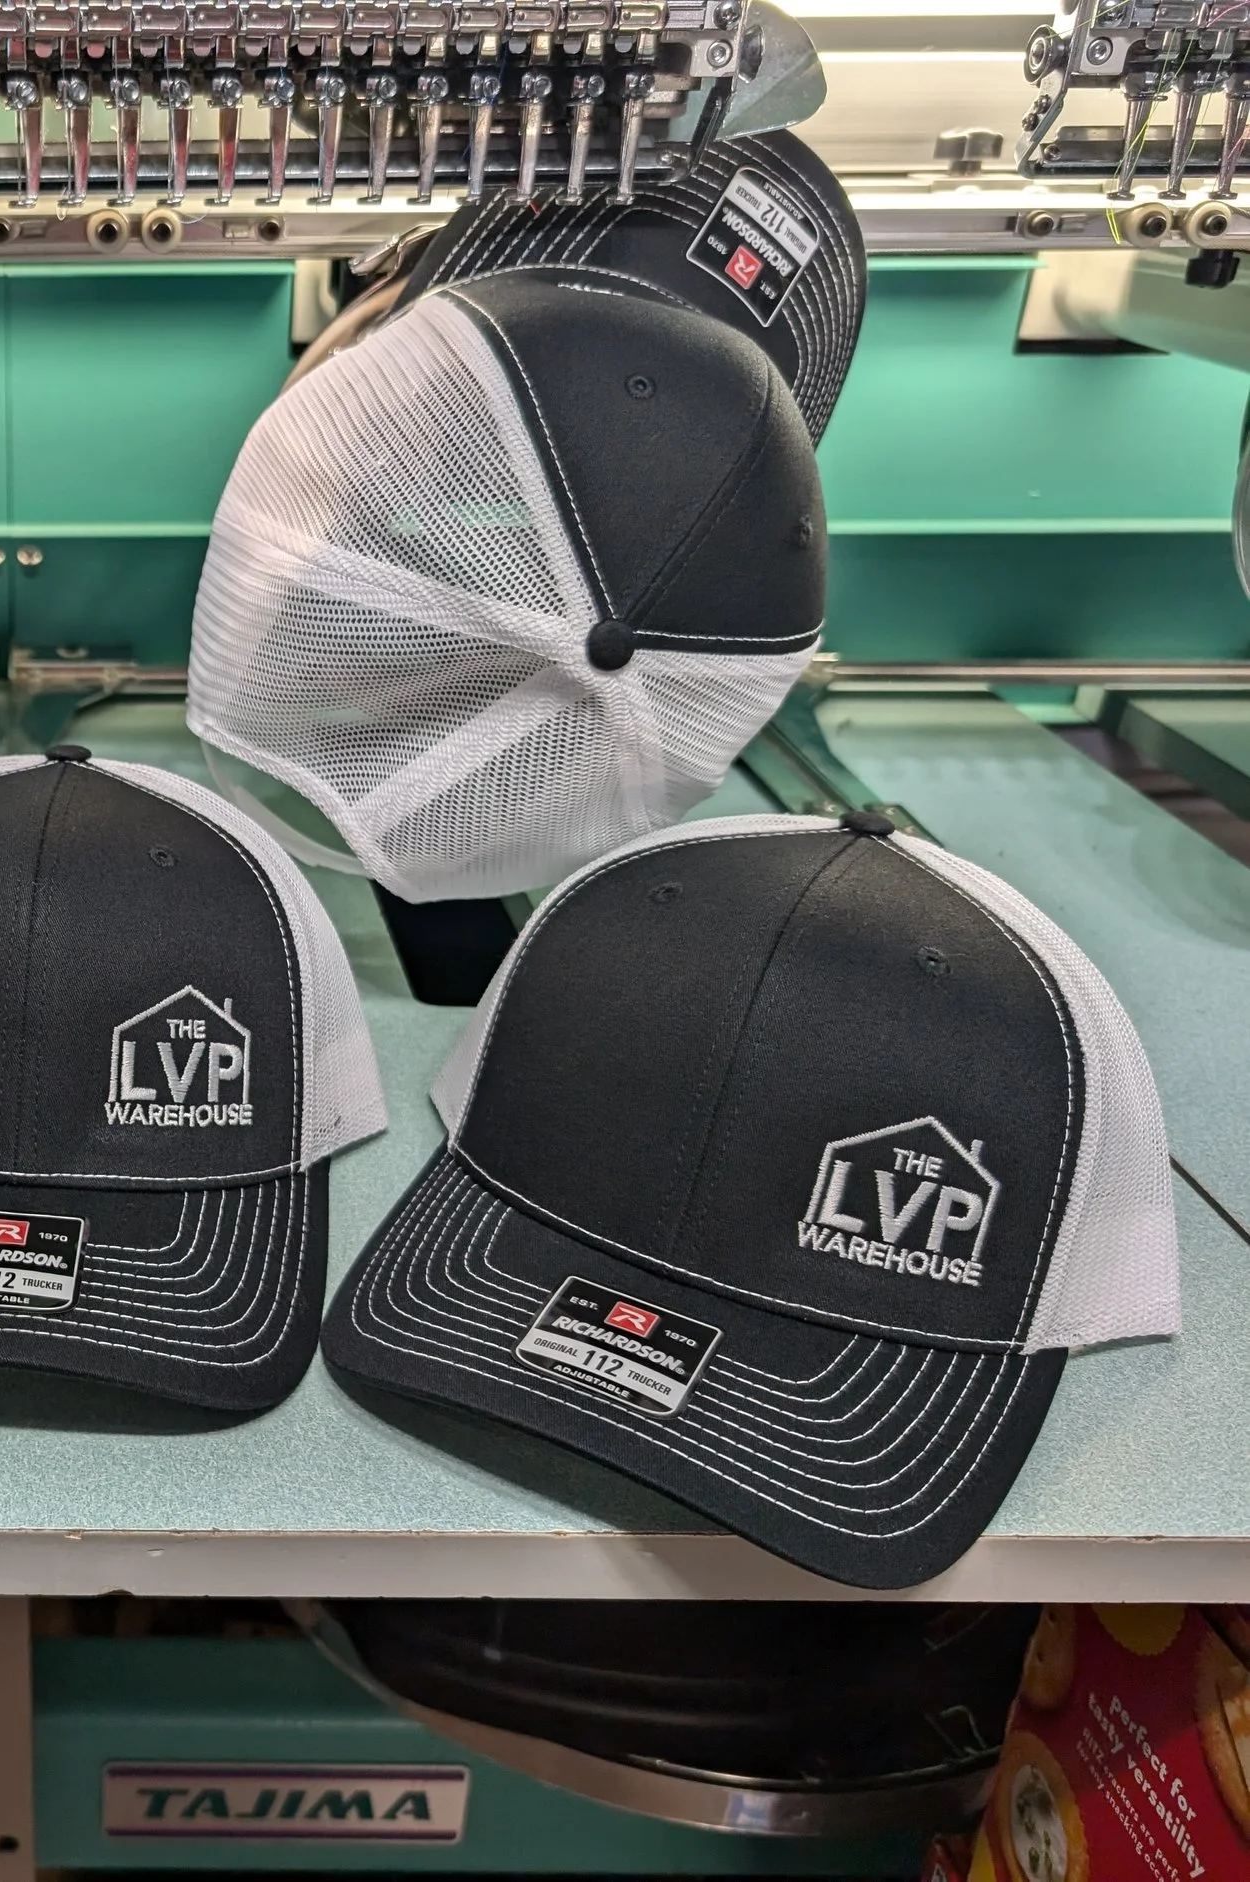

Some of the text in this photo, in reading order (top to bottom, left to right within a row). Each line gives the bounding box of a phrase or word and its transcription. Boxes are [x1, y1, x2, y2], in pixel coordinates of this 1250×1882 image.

[735, 185, 761, 209] TRUCKER
[763, 183, 804, 220] ADJUSTABLE
[761, 203, 786, 234] 112
[707, 235, 728, 255] 1970
[167, 1019, 206, 1039] THE
[120, 1041, 243, 1102] LVP
[104, 1102, 254, 1127] WAREHOUSE
[893, 1147, 945, 1178] THE
[817, 1160, 982, 1252] LVP
[39, 1232, 68, 1242] 1970
[797, 1220, 984, 1287] WAREHOUSE
[22, 1278, 63, 1291] TRUCKER
[569, 1296, 696, 1347] EST. 1970
[533, 1337, 672, 1396] ORIGINAL 112 TRUCKER
[553, 1365, 630, 1398] ADJUSTABLE
[1109, 1695, 1197, 1821] perfect for
[1088, 1692, 1205, 1879] tasty versatility
[137, 1788, 431, 1820] TAJIMA
[1103, 1766, 1139, 1821] crackers
[1140, 1824, 1155, 1846] are
[1105, 1791, 1144, 1855] snacking
